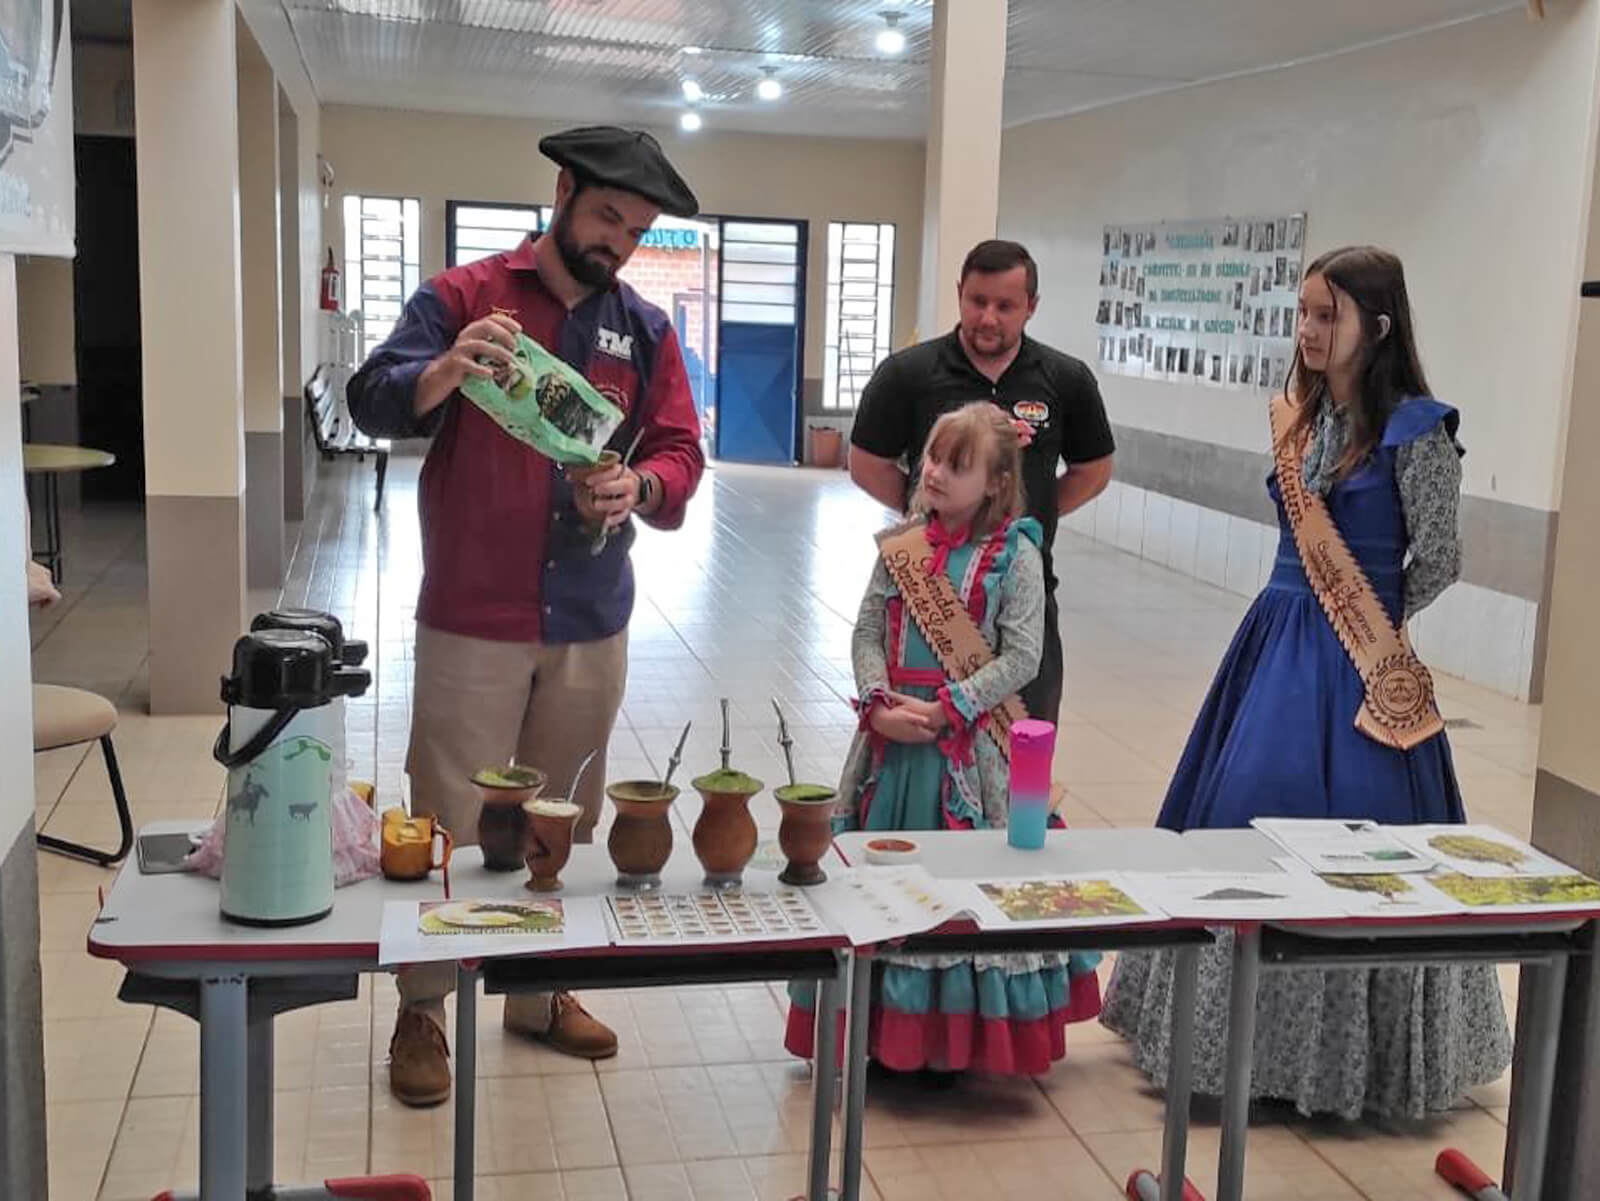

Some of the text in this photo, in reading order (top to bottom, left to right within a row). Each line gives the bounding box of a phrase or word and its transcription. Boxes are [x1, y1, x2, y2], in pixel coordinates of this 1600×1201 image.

[888, 549, 955, 657] Dente de Leite
